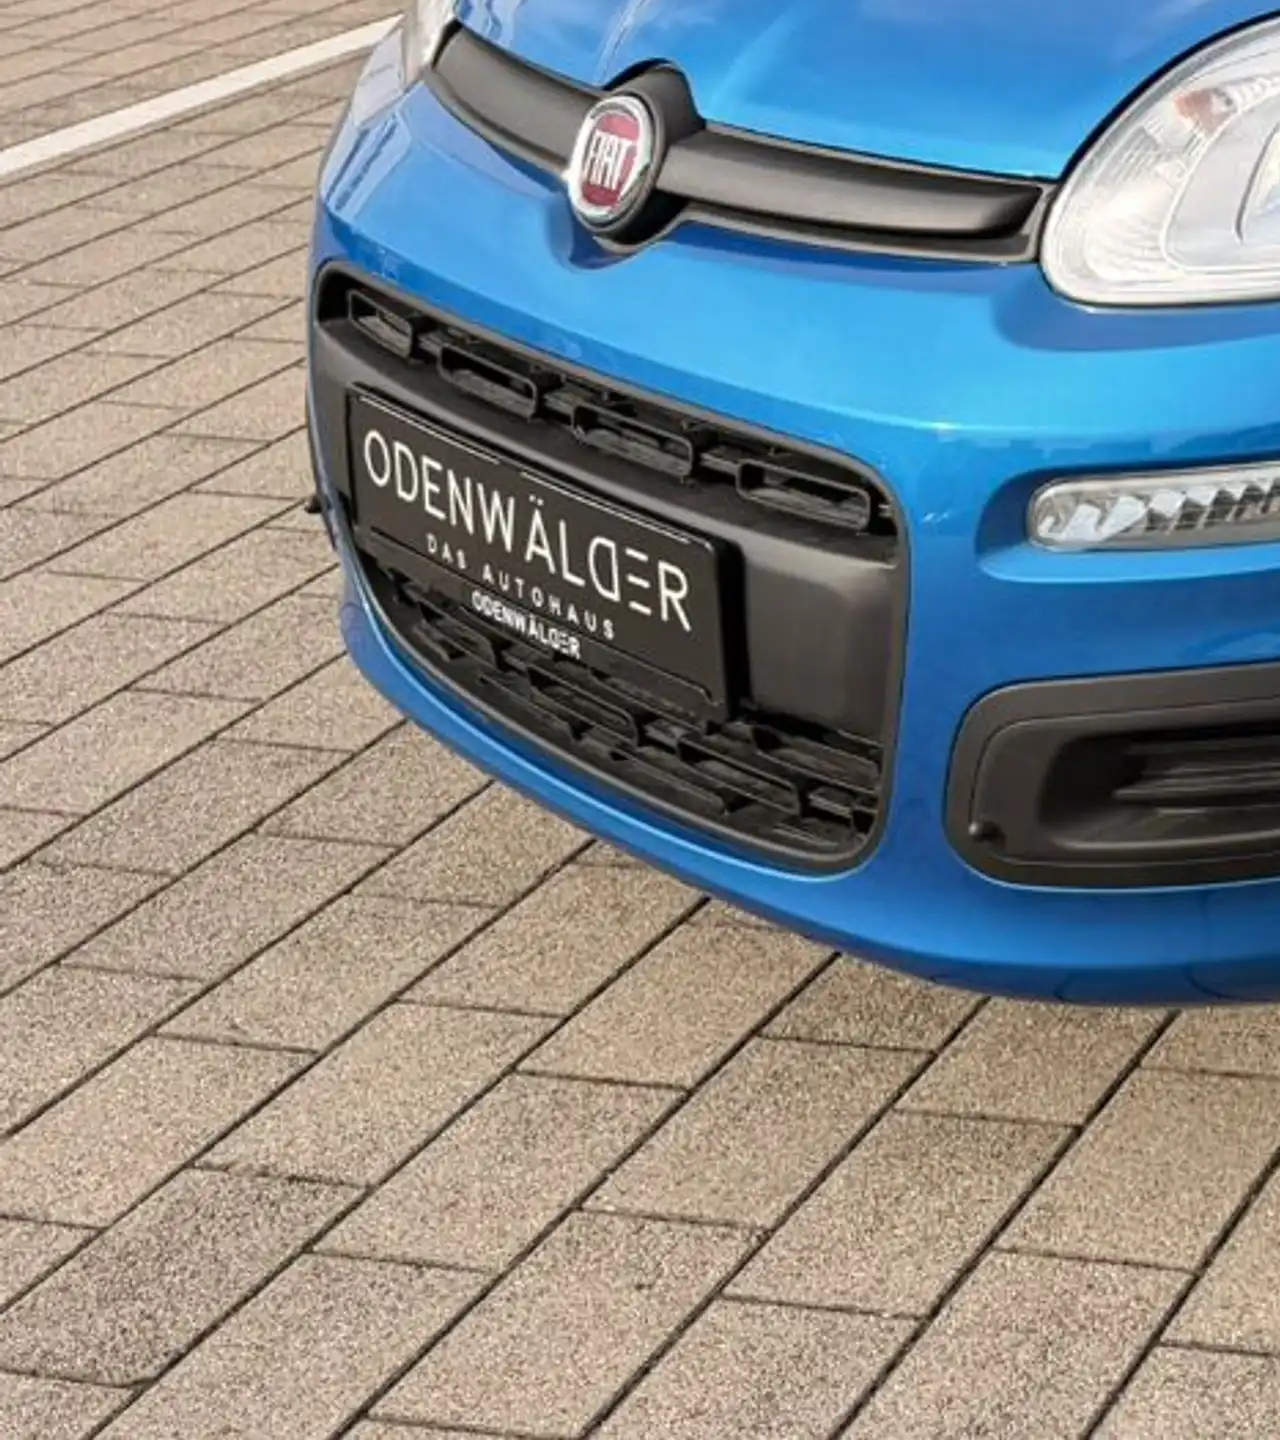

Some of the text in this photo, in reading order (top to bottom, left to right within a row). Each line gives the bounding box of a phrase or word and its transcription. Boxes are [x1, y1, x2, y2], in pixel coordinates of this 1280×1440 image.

[583, 128, 634, 192] FIAT
[363, 429, 692, 633] ODENWÄLDER
[426, 533, 616, 640] DAS AUTOHAUS
[471, 589, 582, 660] ODENWÄLDER
